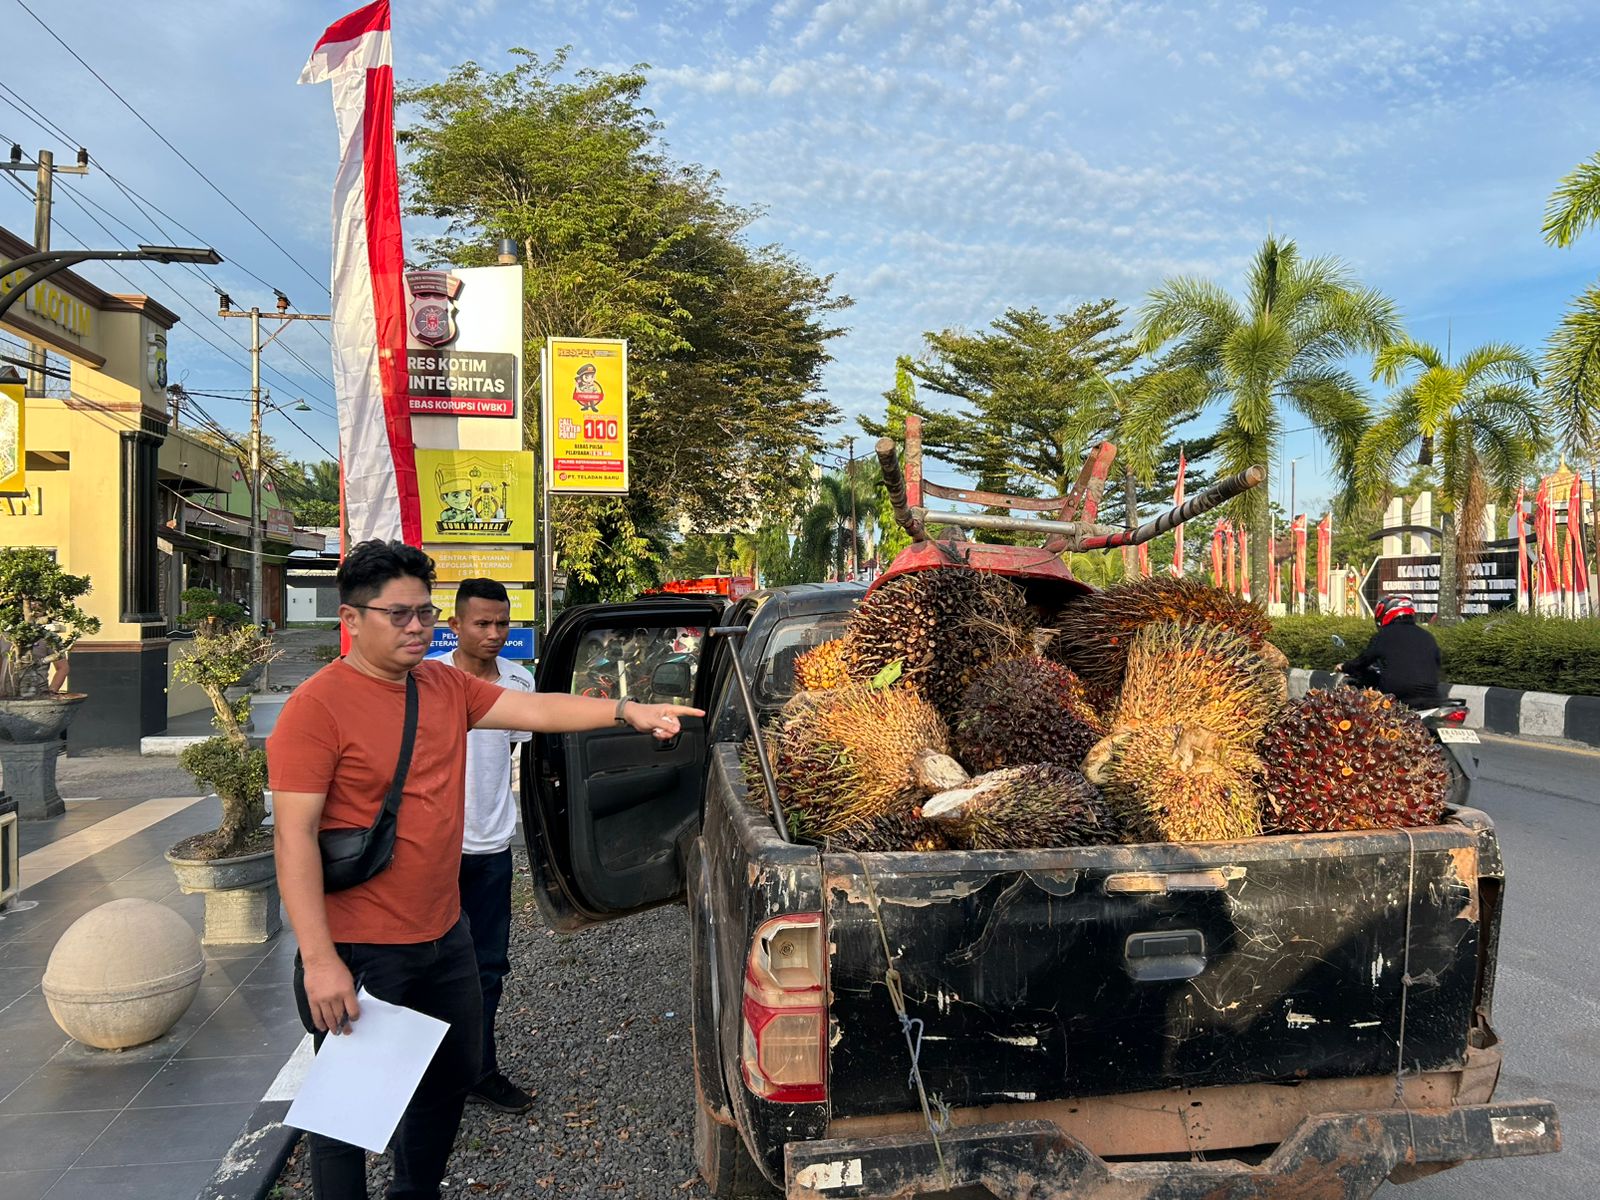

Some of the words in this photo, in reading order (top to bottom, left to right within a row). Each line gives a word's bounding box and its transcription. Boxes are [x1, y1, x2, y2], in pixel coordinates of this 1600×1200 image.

[34, 283, 91, 337] KOTIM
[407, 357, 435, 370] RES
[438, 358, 487, 373] KOTIM
[409, 375, 505, 393] INTEGRITAS
[409, 400, 434, 409] EBAS
[435, 401, 475, 411] KORUPSI
[477, 402, 507, 413] (WBK)
[585, 421, 617, 438] 110
